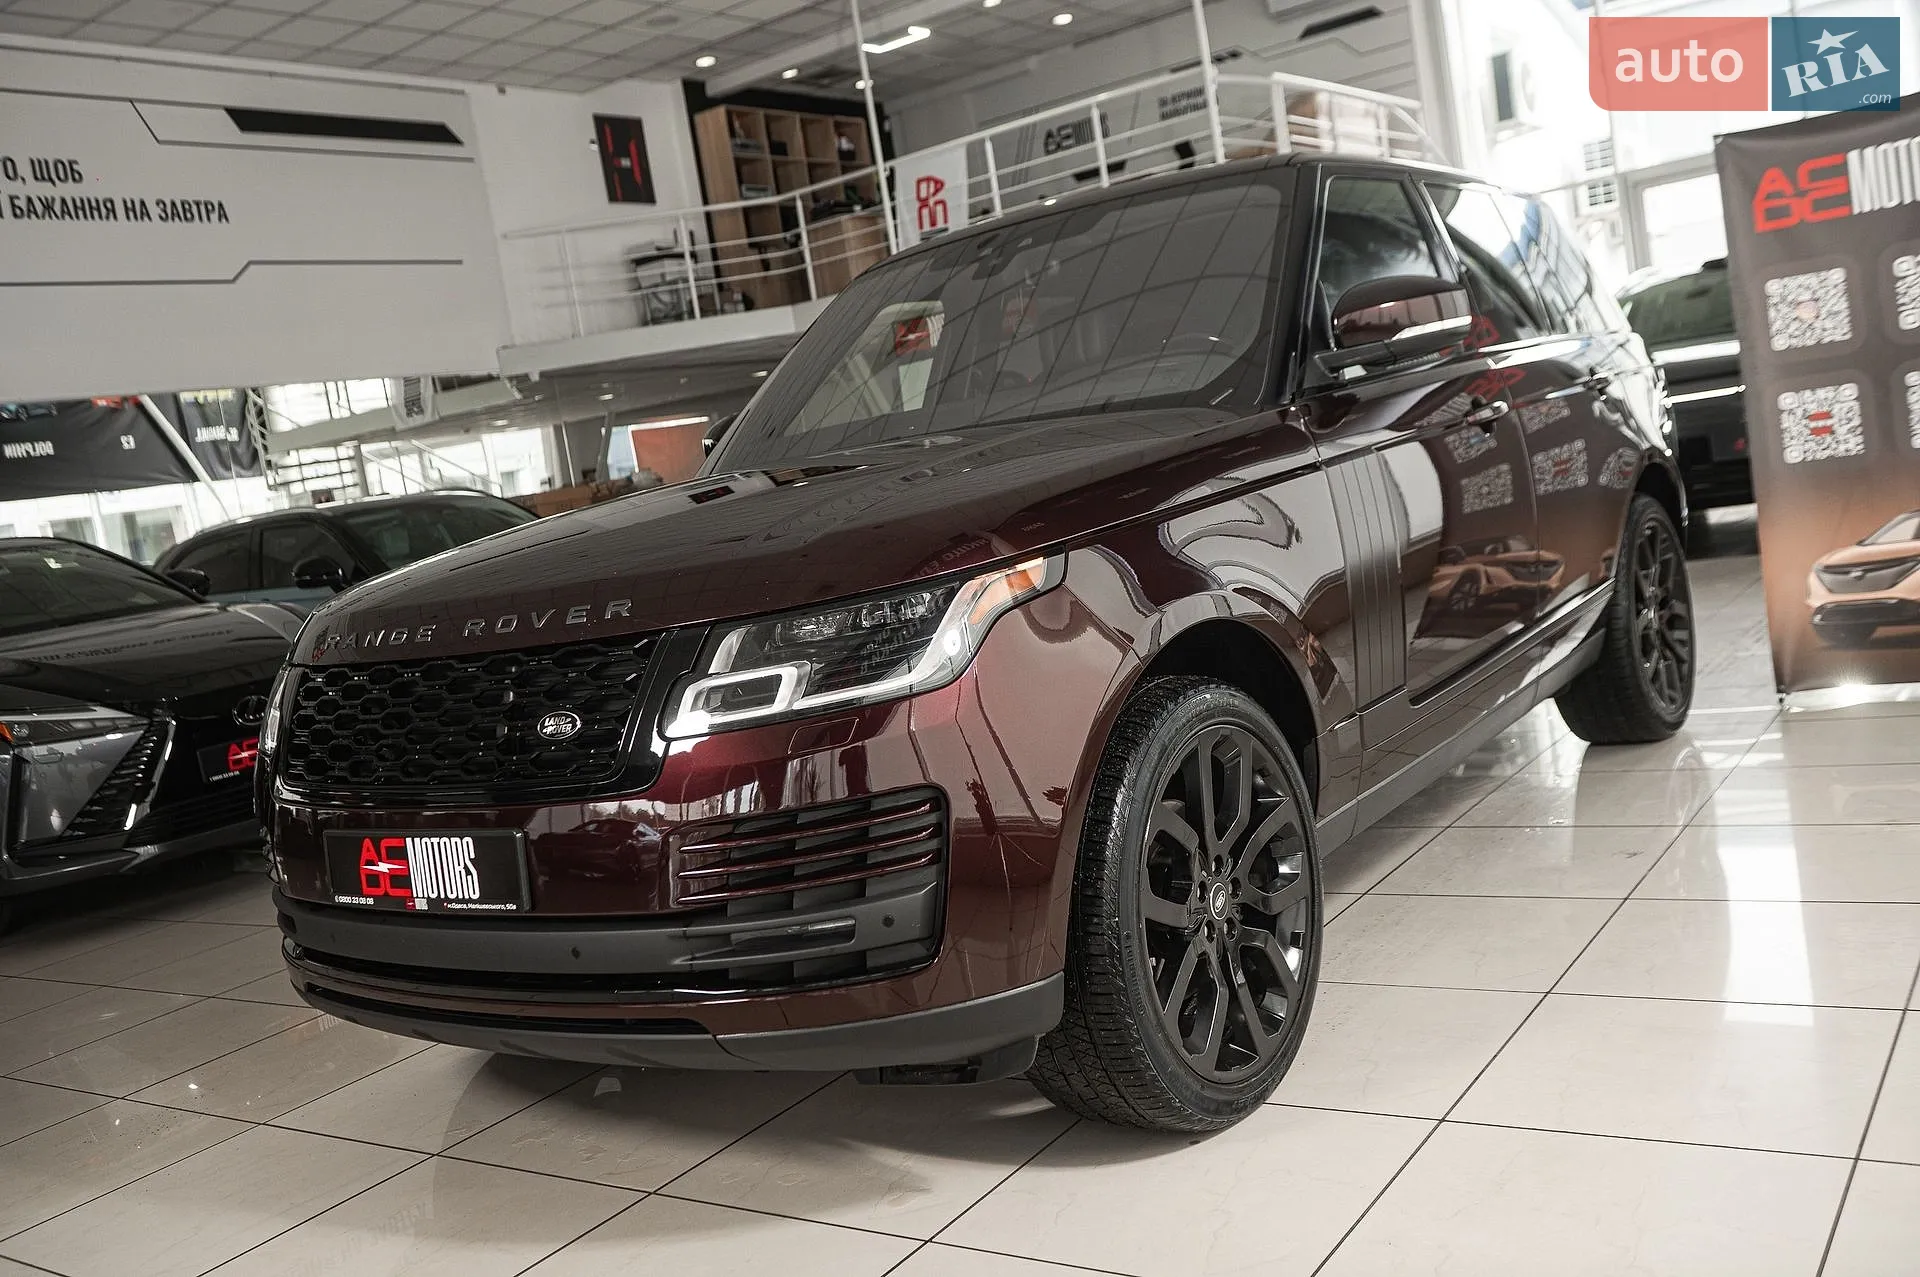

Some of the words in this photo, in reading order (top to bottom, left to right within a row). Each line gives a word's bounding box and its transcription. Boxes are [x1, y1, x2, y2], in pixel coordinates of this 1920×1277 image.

[0, 155, 27, 186] О,
[29, 156, 84, 187] ЩОБ
[8, 194, 118, 222] БАЖАННЯ
[122, 198, 152, 222] НА
[155, 198, 230, 224] ЗАВТРА
[325, 624, 437, 651] RANGE
[462, 599, 634, 638] ROVER
[544, 716, 566, 727] LAND
[546, 723, 573, 735] ROVER
[405, 836, 480, 899] MOTORS
